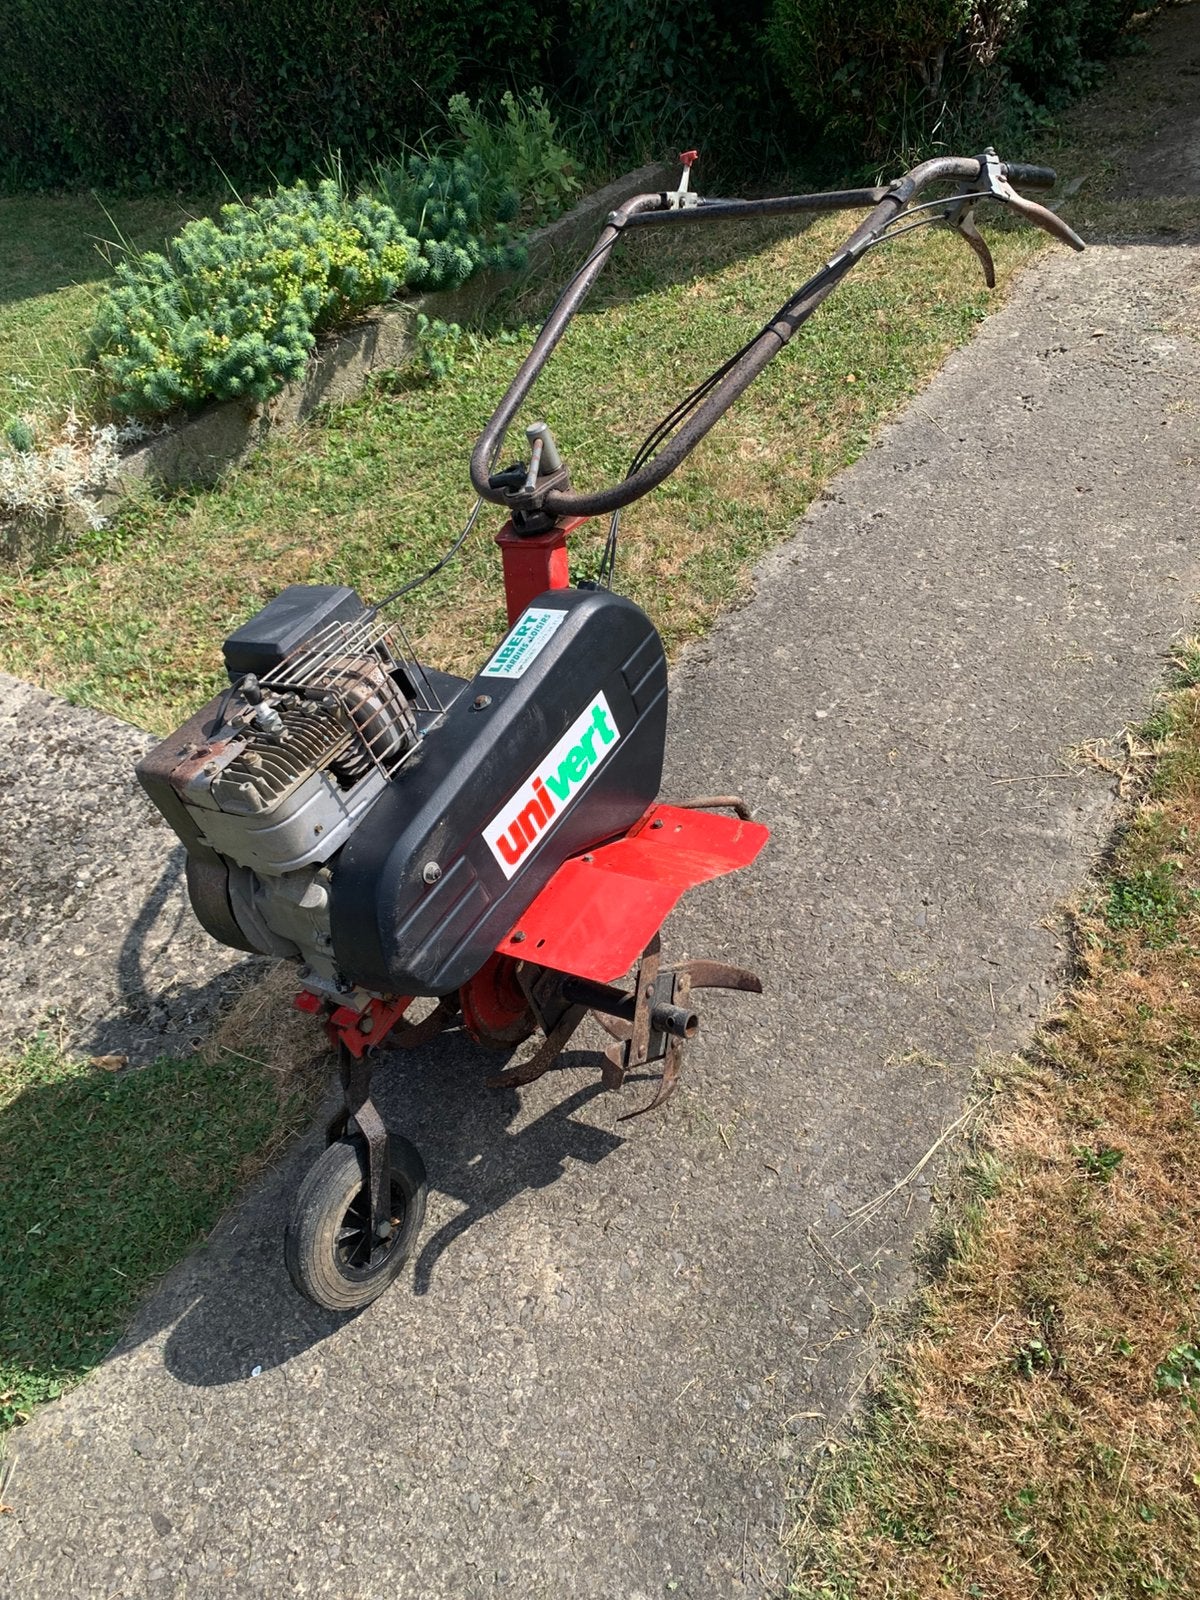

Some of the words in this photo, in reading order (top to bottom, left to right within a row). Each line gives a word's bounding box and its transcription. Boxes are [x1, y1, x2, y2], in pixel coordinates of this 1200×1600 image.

[488, 615, 538, 672] LIBERT
[504, 643, 529, 672] JARDINS
[496, 704, 615, 865] univert
